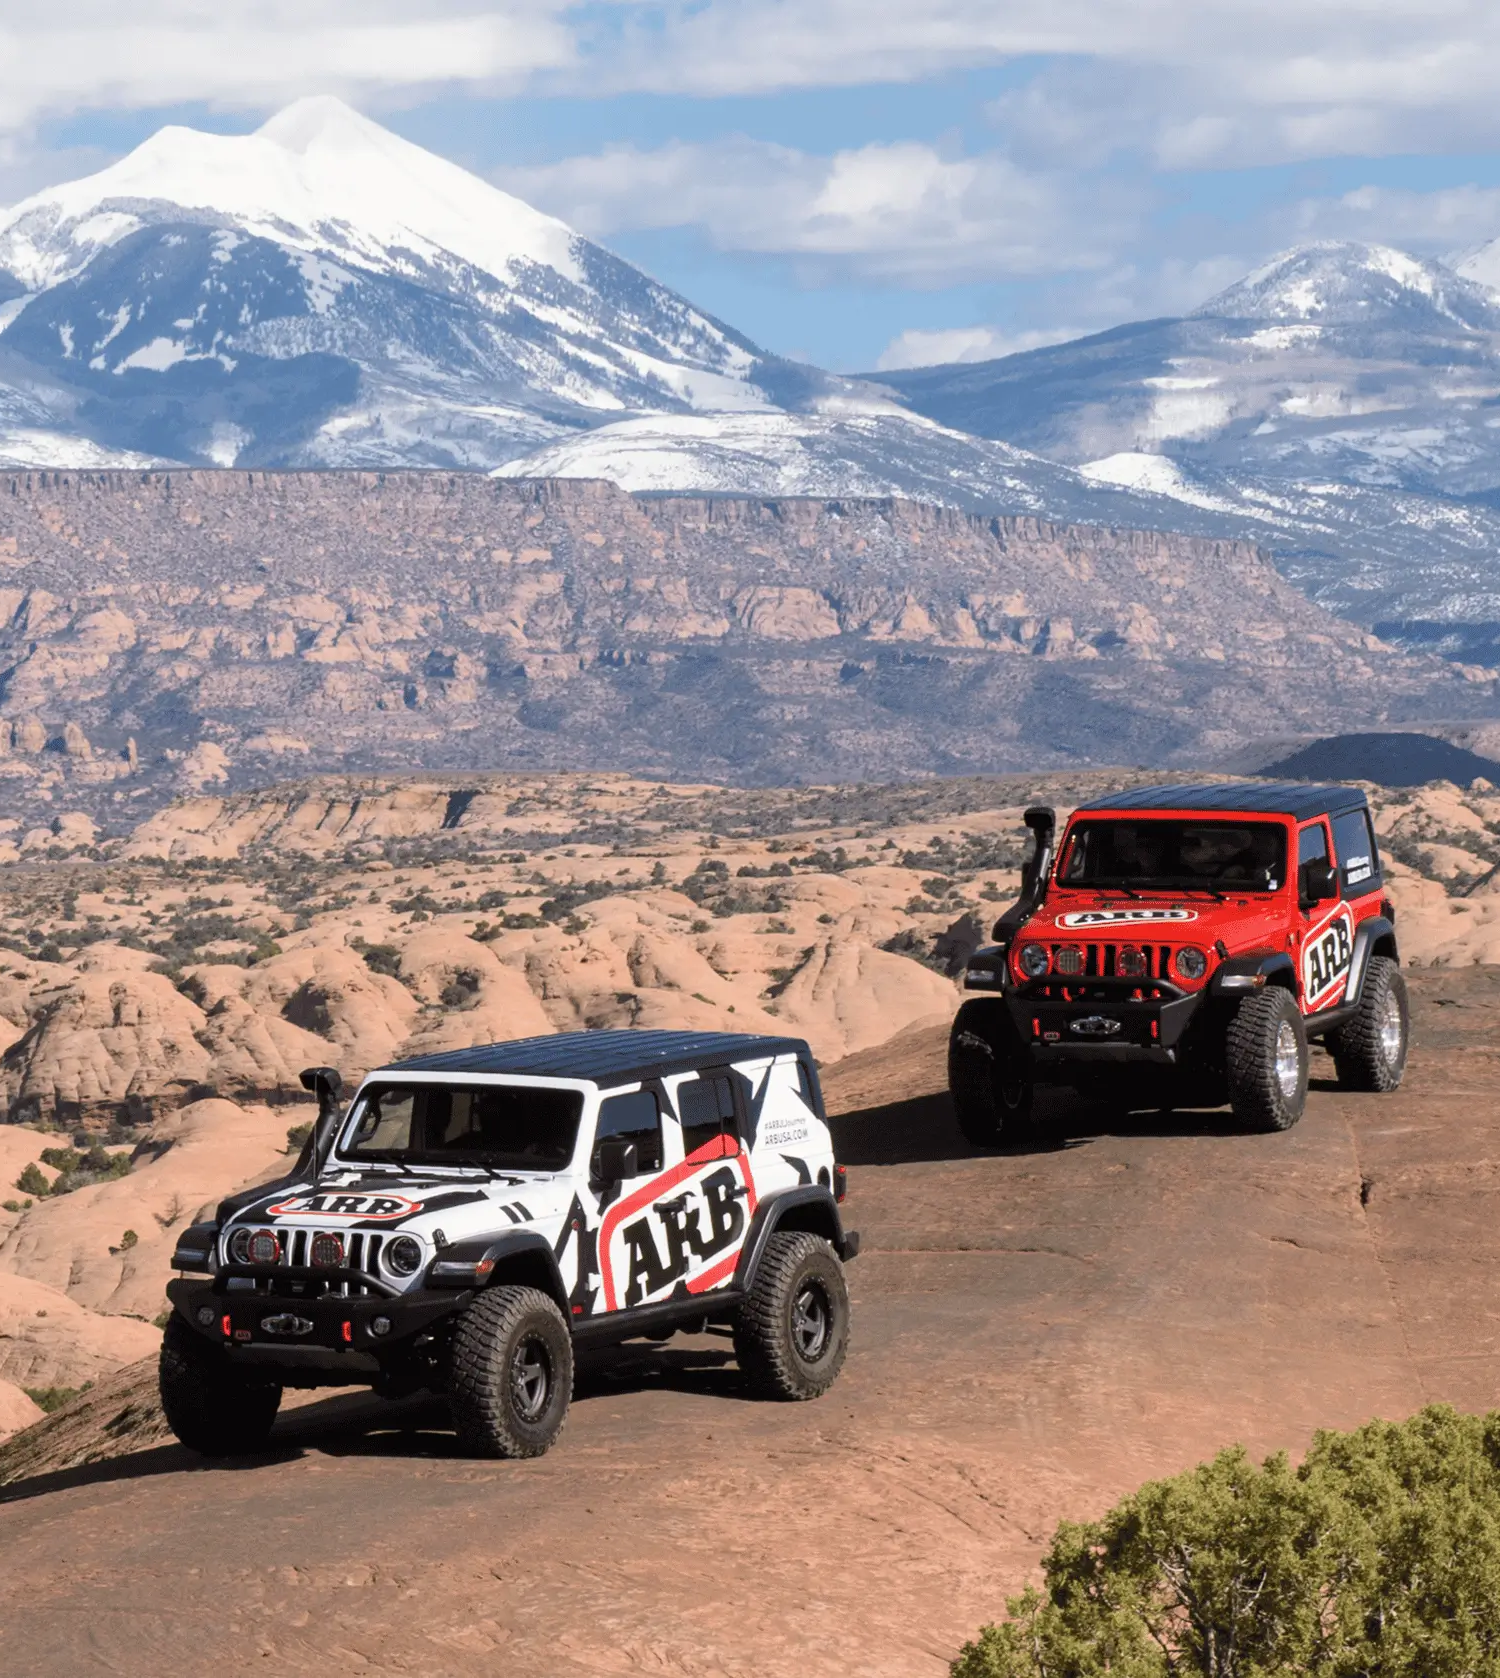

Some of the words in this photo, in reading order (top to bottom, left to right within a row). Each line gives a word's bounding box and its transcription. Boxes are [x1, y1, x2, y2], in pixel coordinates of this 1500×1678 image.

[1074, 912, 1183, 923] ARB
[1309, 918, 1351, 999] ARB
[765, 1128, 808, 1145] ARBUSA.COM
[284, 1195, 404, 1214] ARB
[622, 1165, 744, 1308] ARB
